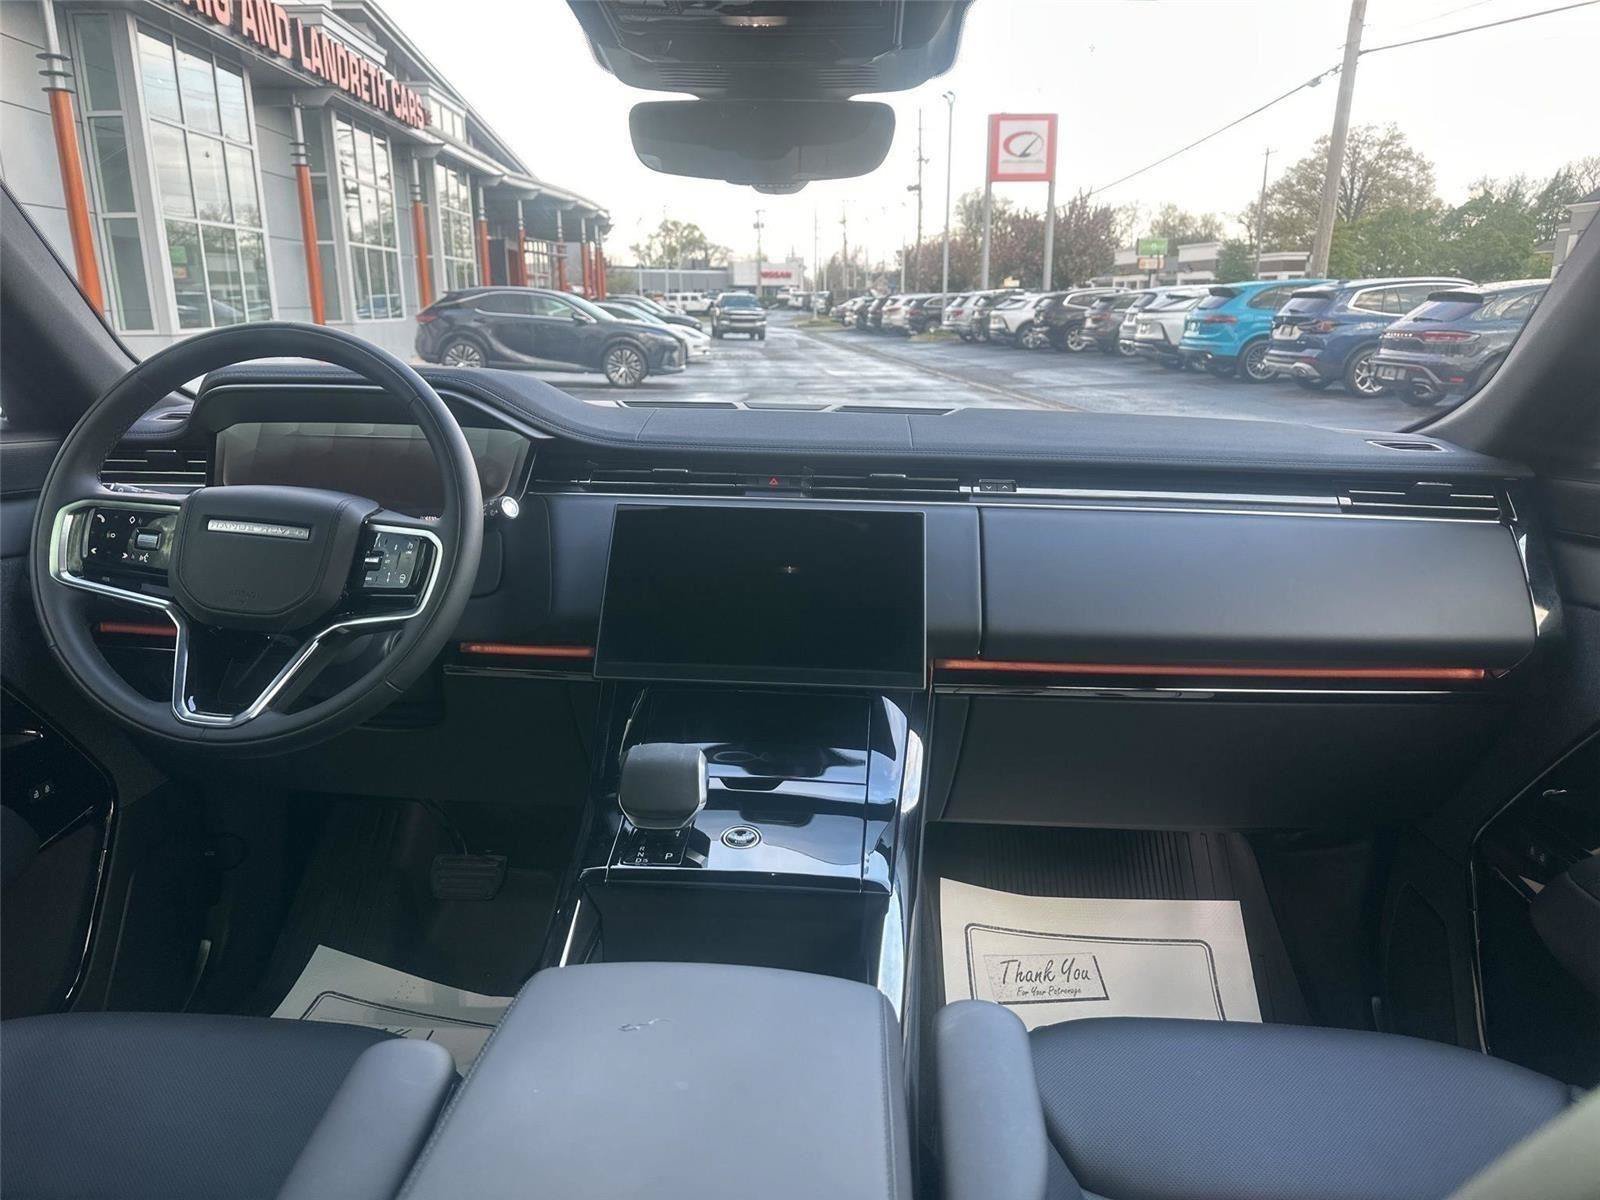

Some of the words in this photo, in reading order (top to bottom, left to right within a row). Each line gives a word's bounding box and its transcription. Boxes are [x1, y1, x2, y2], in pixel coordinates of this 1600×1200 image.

[241, 0, 292, 59] AND
[297, 17, 389, 112] LANDRETH
[391, 79, 425, 130] CARS
[1000, 959, 1056, 985] Thank
[1061, 957, 1091, 983] You
[1017, 986, 1029, 997] For
